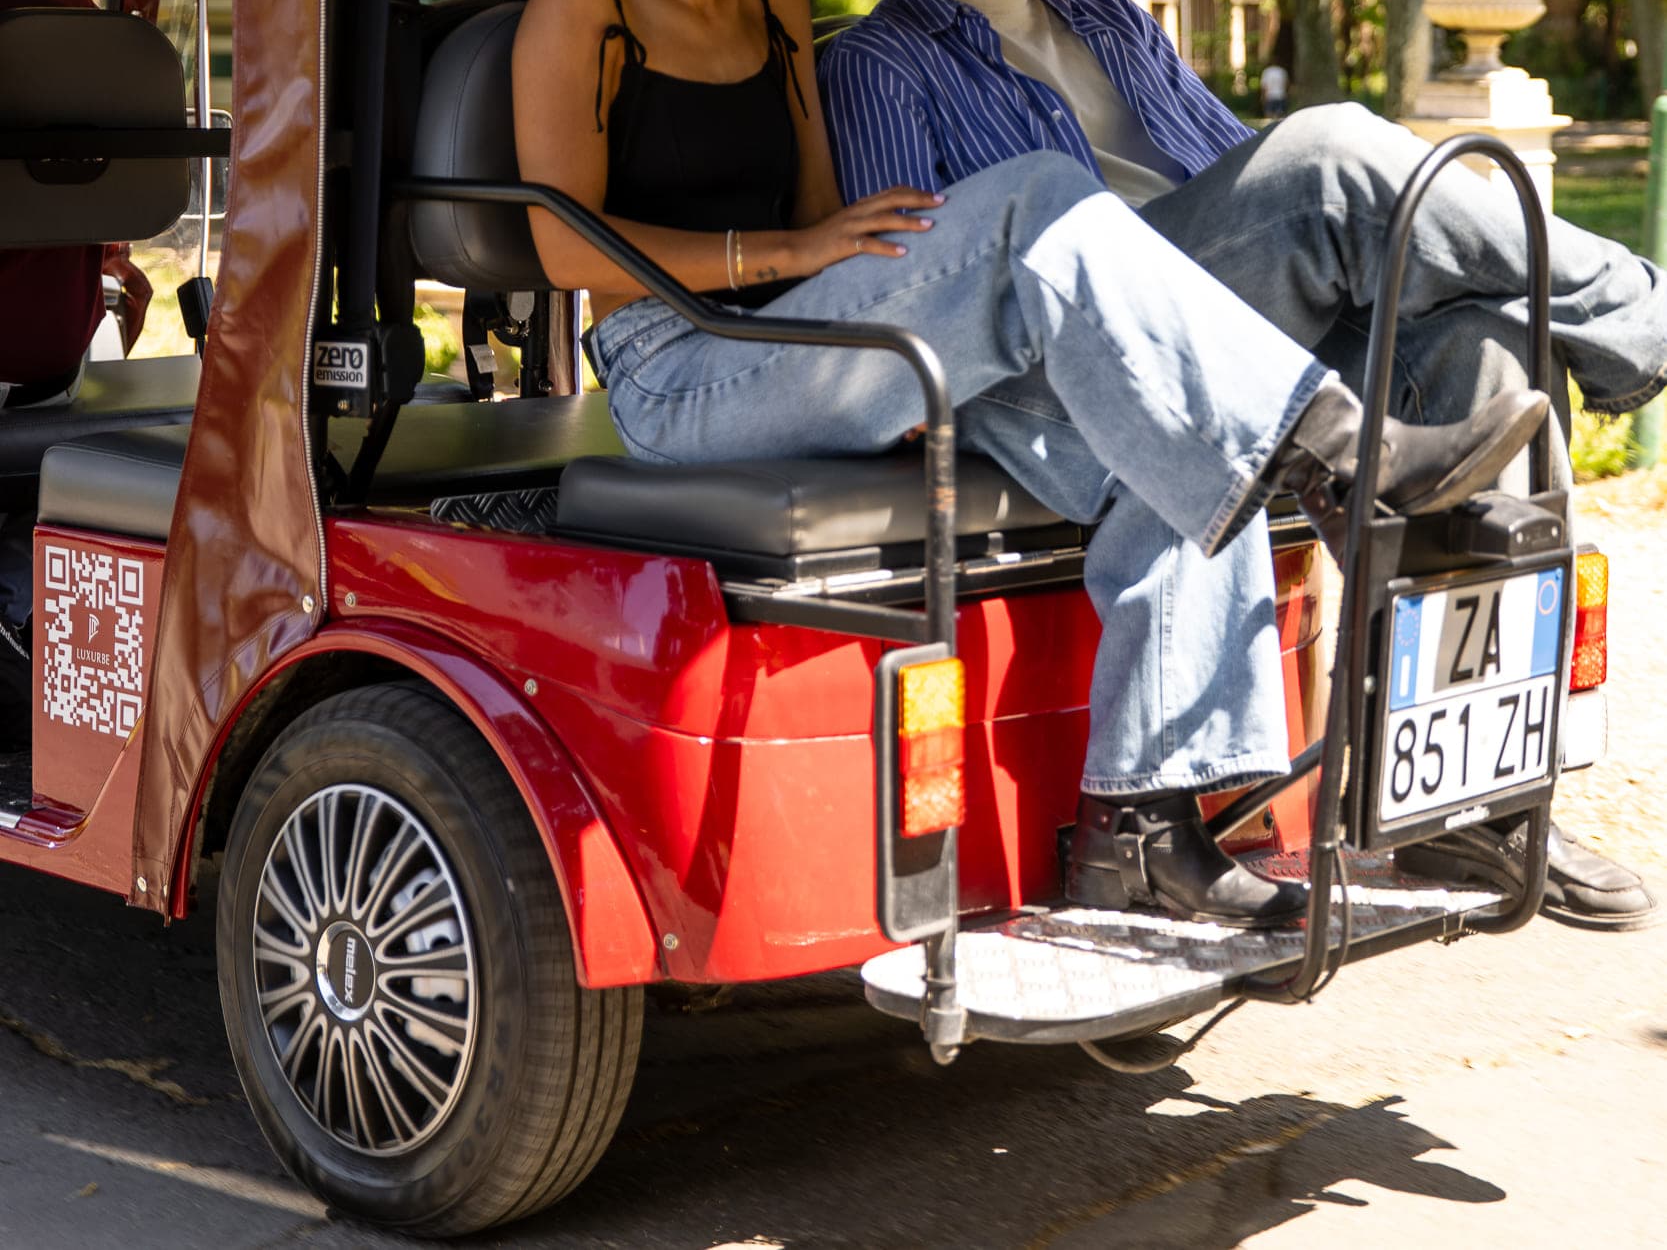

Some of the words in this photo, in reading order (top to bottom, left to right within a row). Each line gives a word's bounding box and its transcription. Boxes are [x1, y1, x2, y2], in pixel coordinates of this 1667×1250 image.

[315, 369, 364, 383] emission
[76, 647, 110, 666] LUXURBE
[1448, 590, 1502, 685] ZA
[1391, 702, 1471, 804] 851
[1493, 685, 1549, 780] ZH
[344, 936, 356, 1004] melex
